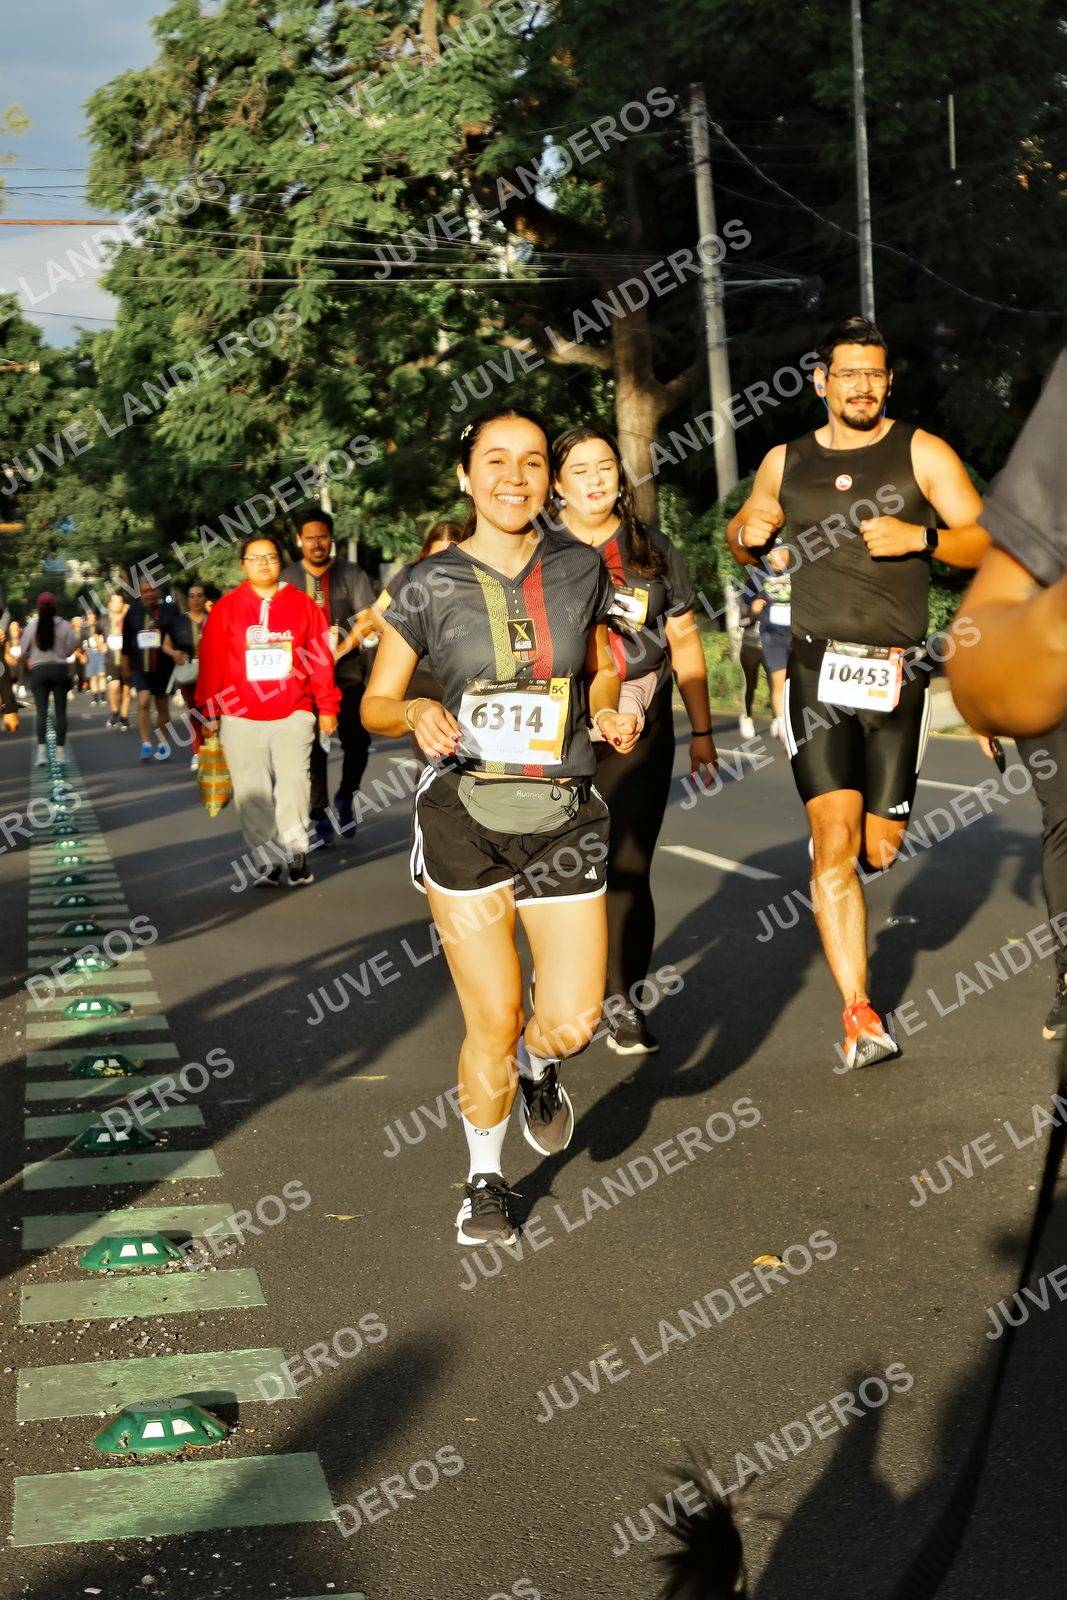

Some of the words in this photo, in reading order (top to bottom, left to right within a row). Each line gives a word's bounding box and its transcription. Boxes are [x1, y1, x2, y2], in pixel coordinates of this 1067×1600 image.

[253, 654, 282, 667] 5737
[828, 662, 889, 687] 10453
[551, 685, 565, 695] 5K
[471, 702, 543, 733] 6314
